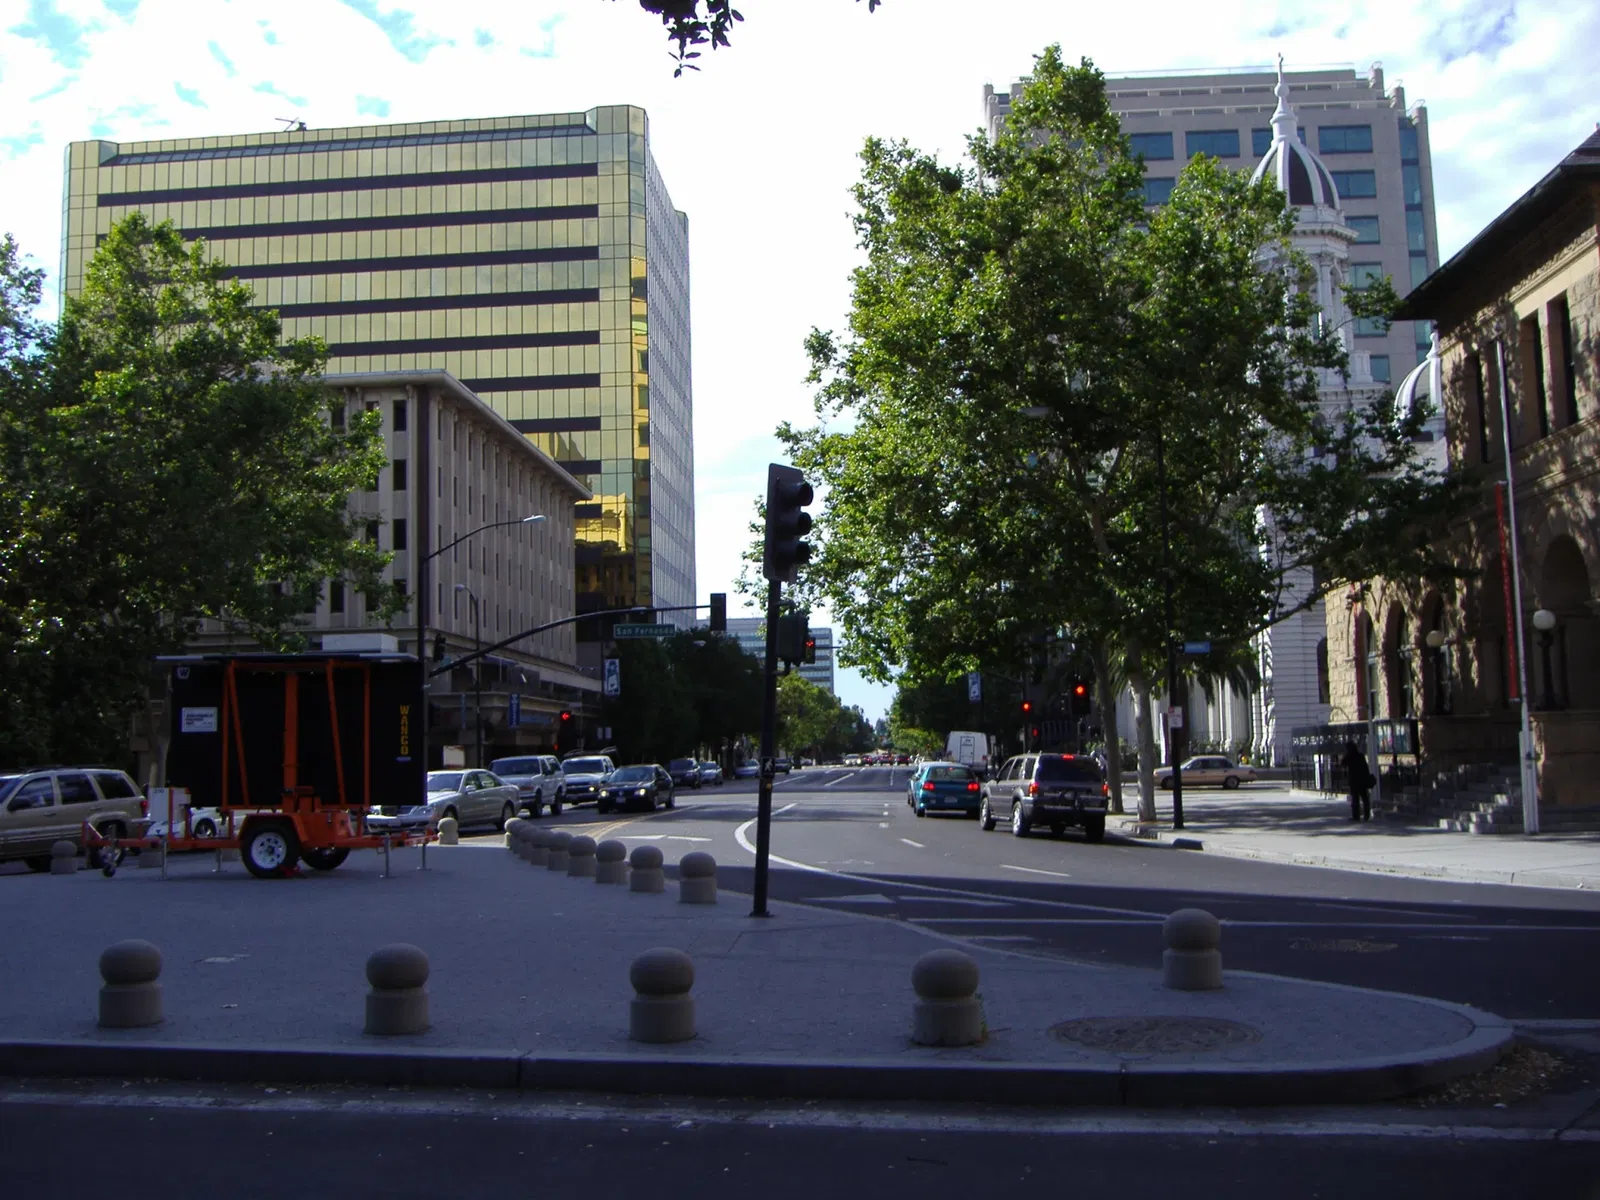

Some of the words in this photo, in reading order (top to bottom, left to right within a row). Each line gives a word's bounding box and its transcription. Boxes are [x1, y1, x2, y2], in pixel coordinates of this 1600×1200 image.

[616, 627, 632, 635] San
[635, 627, 674, 635] Fernando
[400, 704, 410, 756] WANCO
